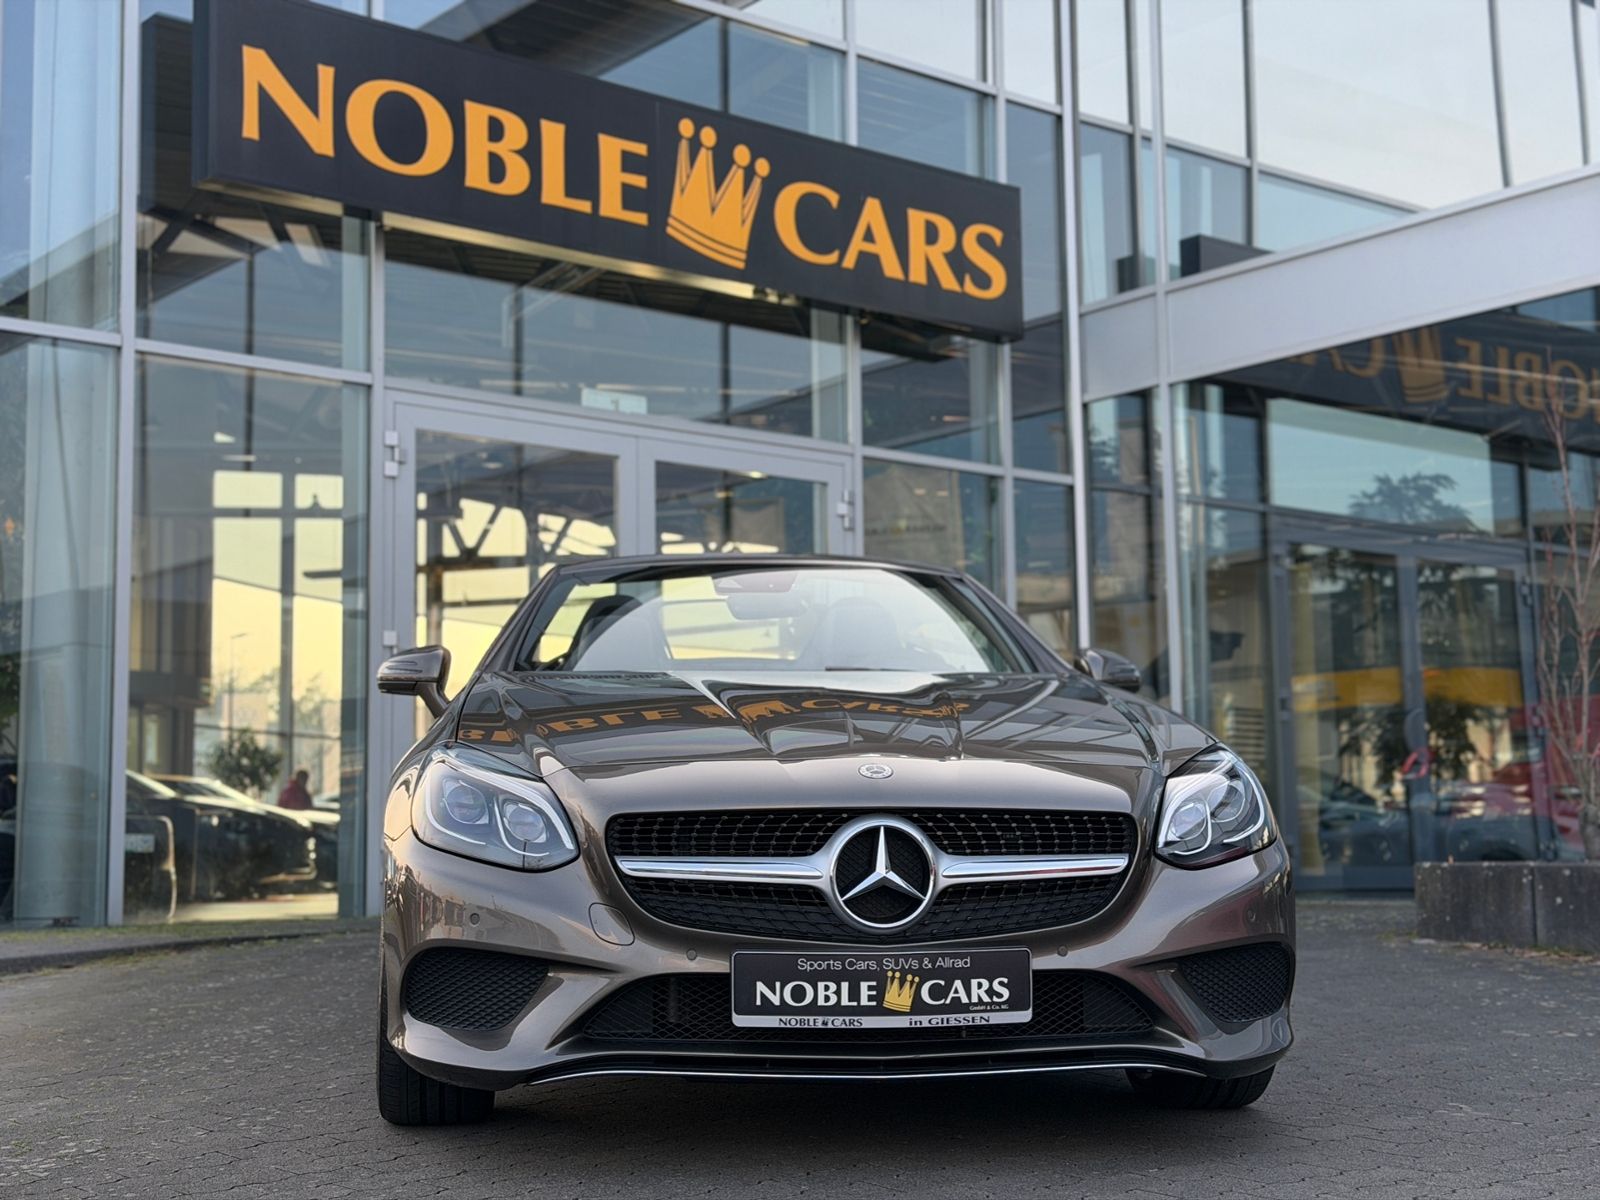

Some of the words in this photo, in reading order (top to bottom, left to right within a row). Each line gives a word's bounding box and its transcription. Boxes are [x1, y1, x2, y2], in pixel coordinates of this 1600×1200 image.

[241, 44, 650, 227] NOBLE
[773, 180, 1009, 301] CARS
[797, 958, 842, 972] Sports
[844, 958, 880, 971] Cars,
[882, 957, 919, 969] SUVs
[922, 957, 933, 969] &
[935, 956, 971, 968] Allrad
[755, 981, 878, 1005] NOBLE
[920, 977, 1010, 1005] CARS
[778, 1018, 820, 1027] NOBLE
[831, 1018, 863, 1027] CARS
[909, 1017, 923, 1027] in
[927, 1015, 991, 1026] GIESSEN
